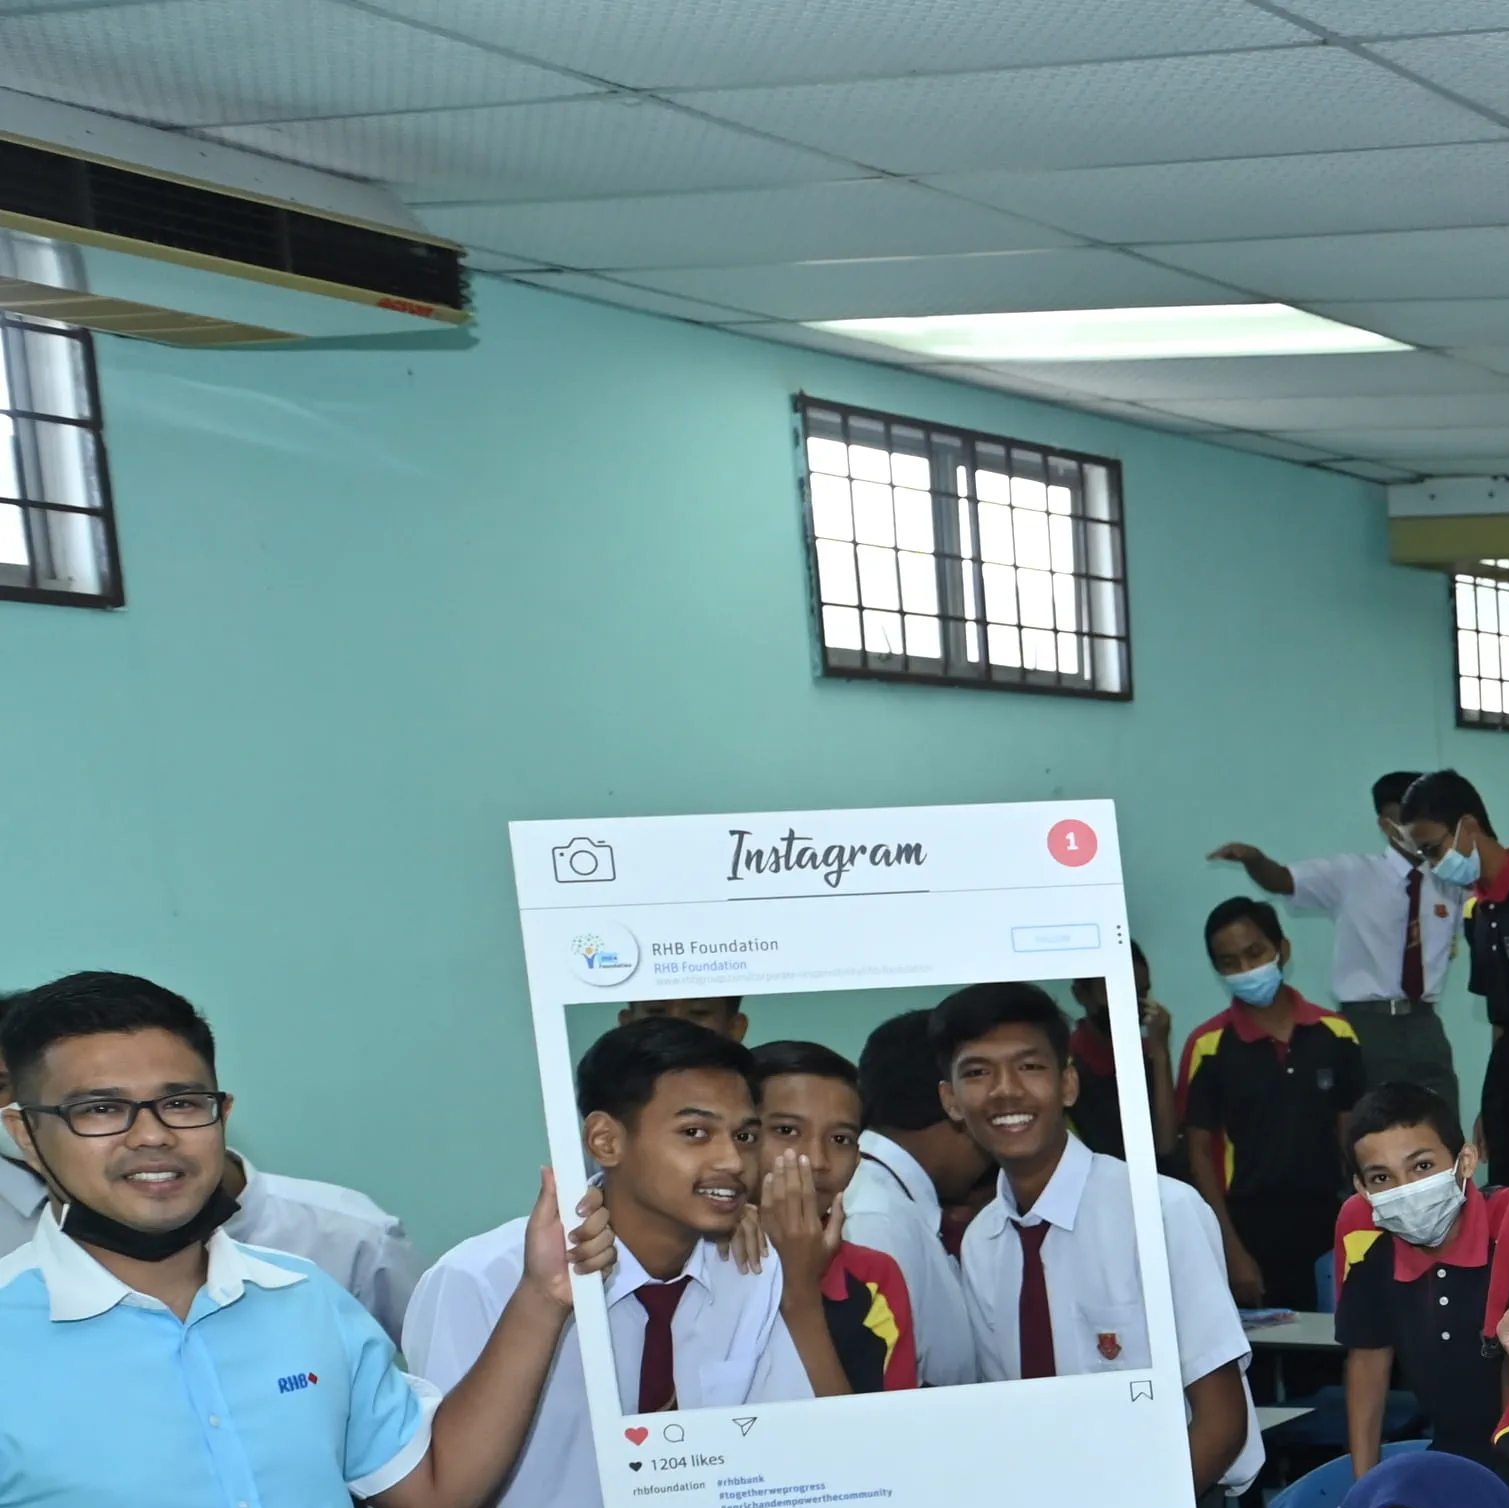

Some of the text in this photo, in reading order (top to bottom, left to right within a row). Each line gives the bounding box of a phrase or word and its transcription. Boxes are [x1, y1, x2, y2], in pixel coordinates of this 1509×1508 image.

[1064, 831, 1080, 851] 1
[726, 827, 928, 888] Instagram
[652, 938, 779, 957] RHB Foundation
[654, 959, 748, 974] RHB Foundation
[277, 1371, 309, 1394] RHB
[651, 1455, 725, 1471] 1204 likes
[632, 1481, 706, 1496] rhbfoundation
[717, 1475, 765, 1487] #rhbbank
[719, 1481, 826, 1500] #togetherweprogress
